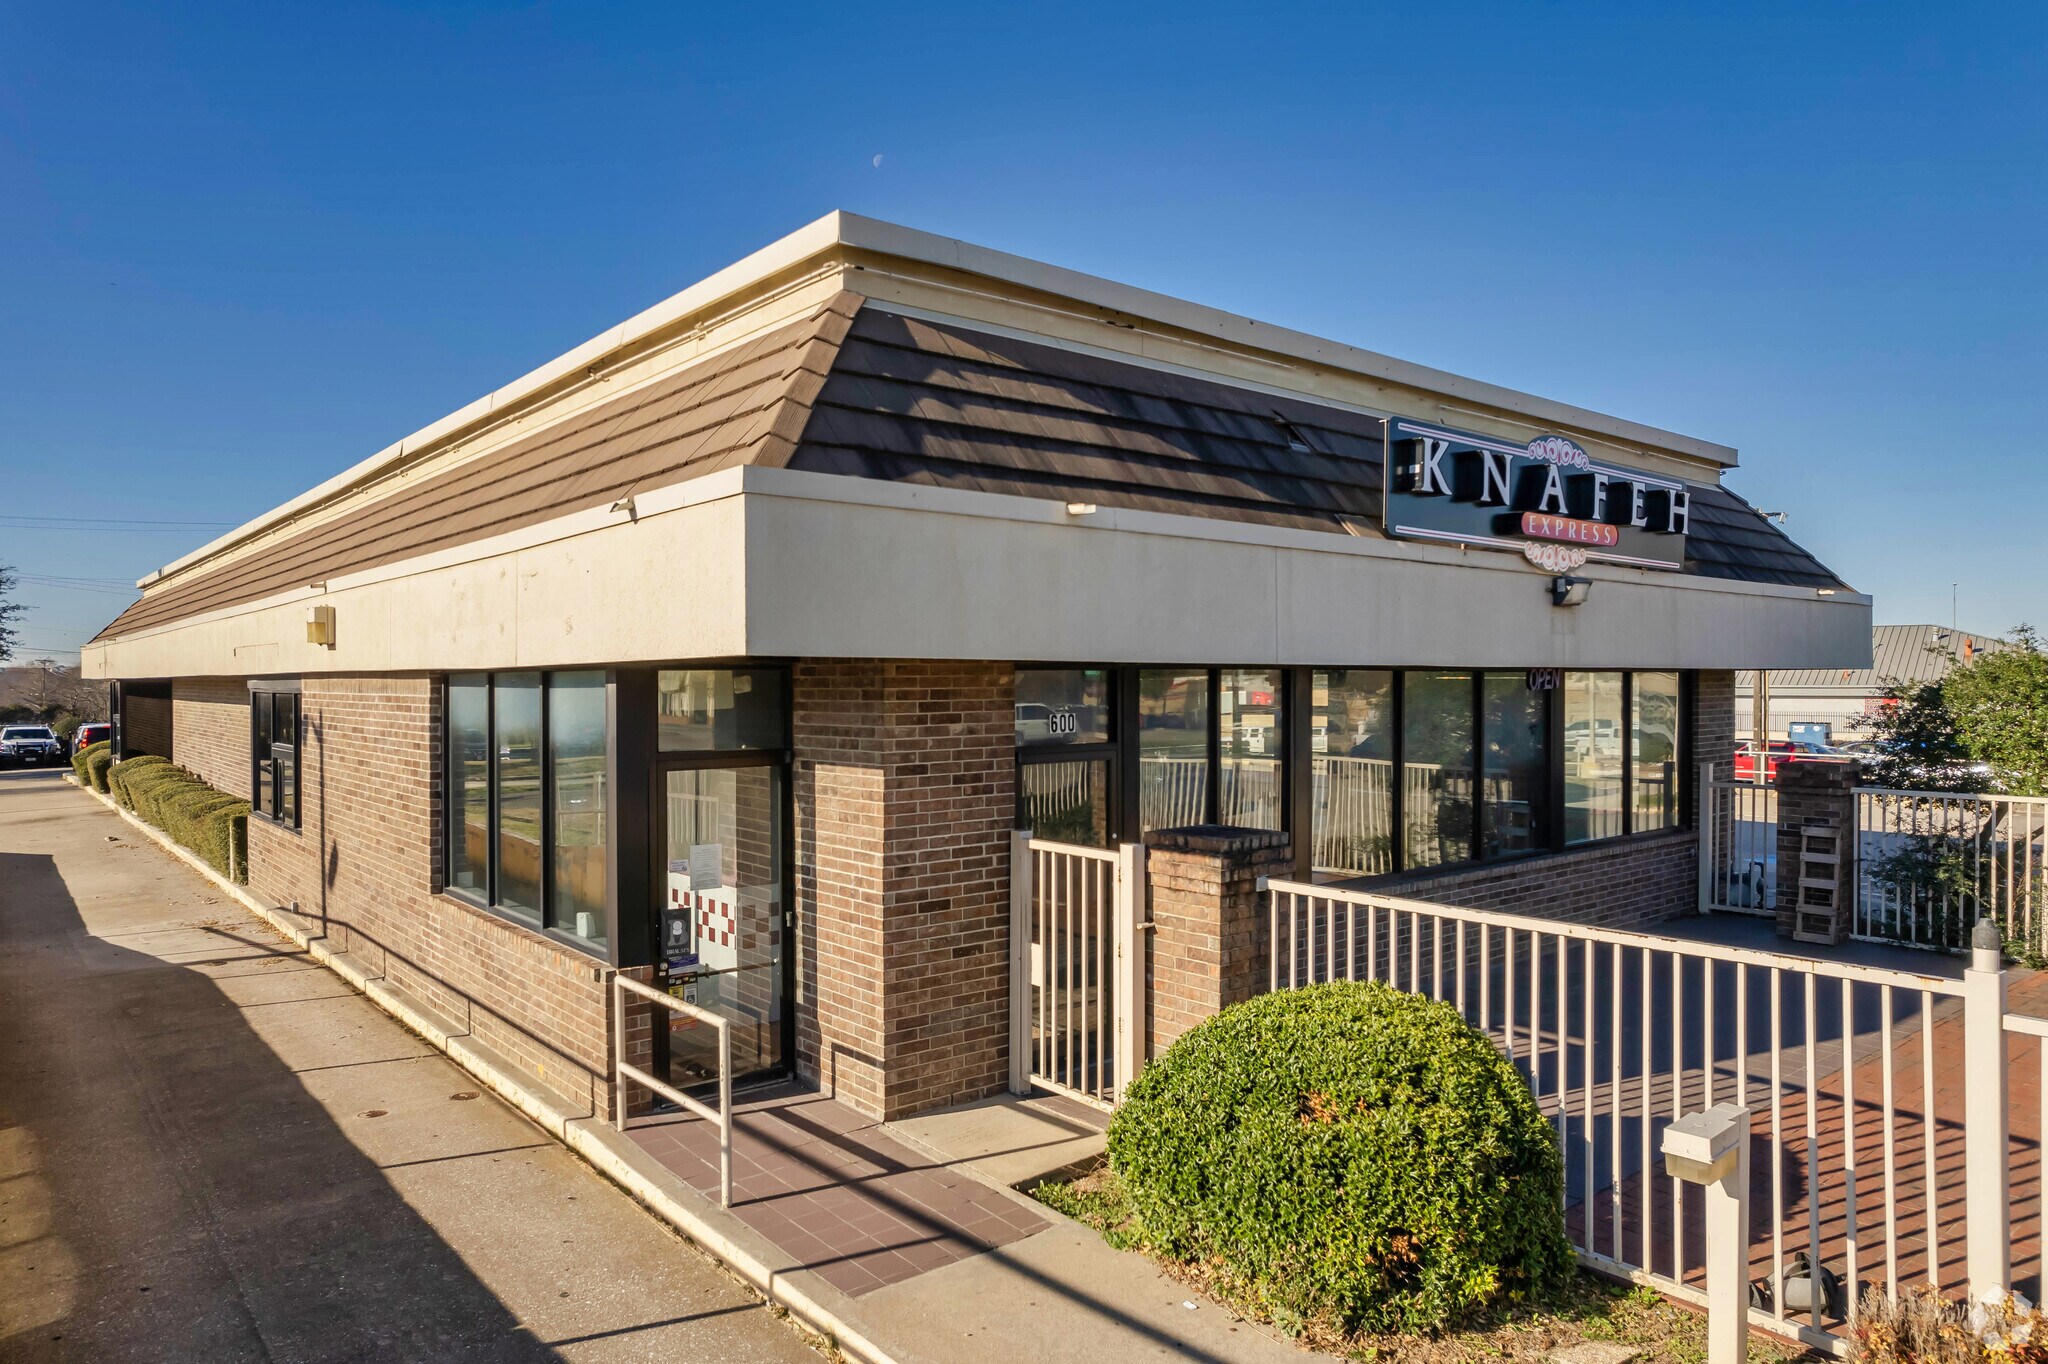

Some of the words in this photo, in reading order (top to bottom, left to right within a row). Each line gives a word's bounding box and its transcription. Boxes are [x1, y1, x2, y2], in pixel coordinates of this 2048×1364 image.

[1413, 437, 1690, 534] KNAFEH
[1528, 514, 1611, 543] EXPRESS
[1530, 668, 1560, 690] OPEN
[1050, 713, 1075, 733] 600
